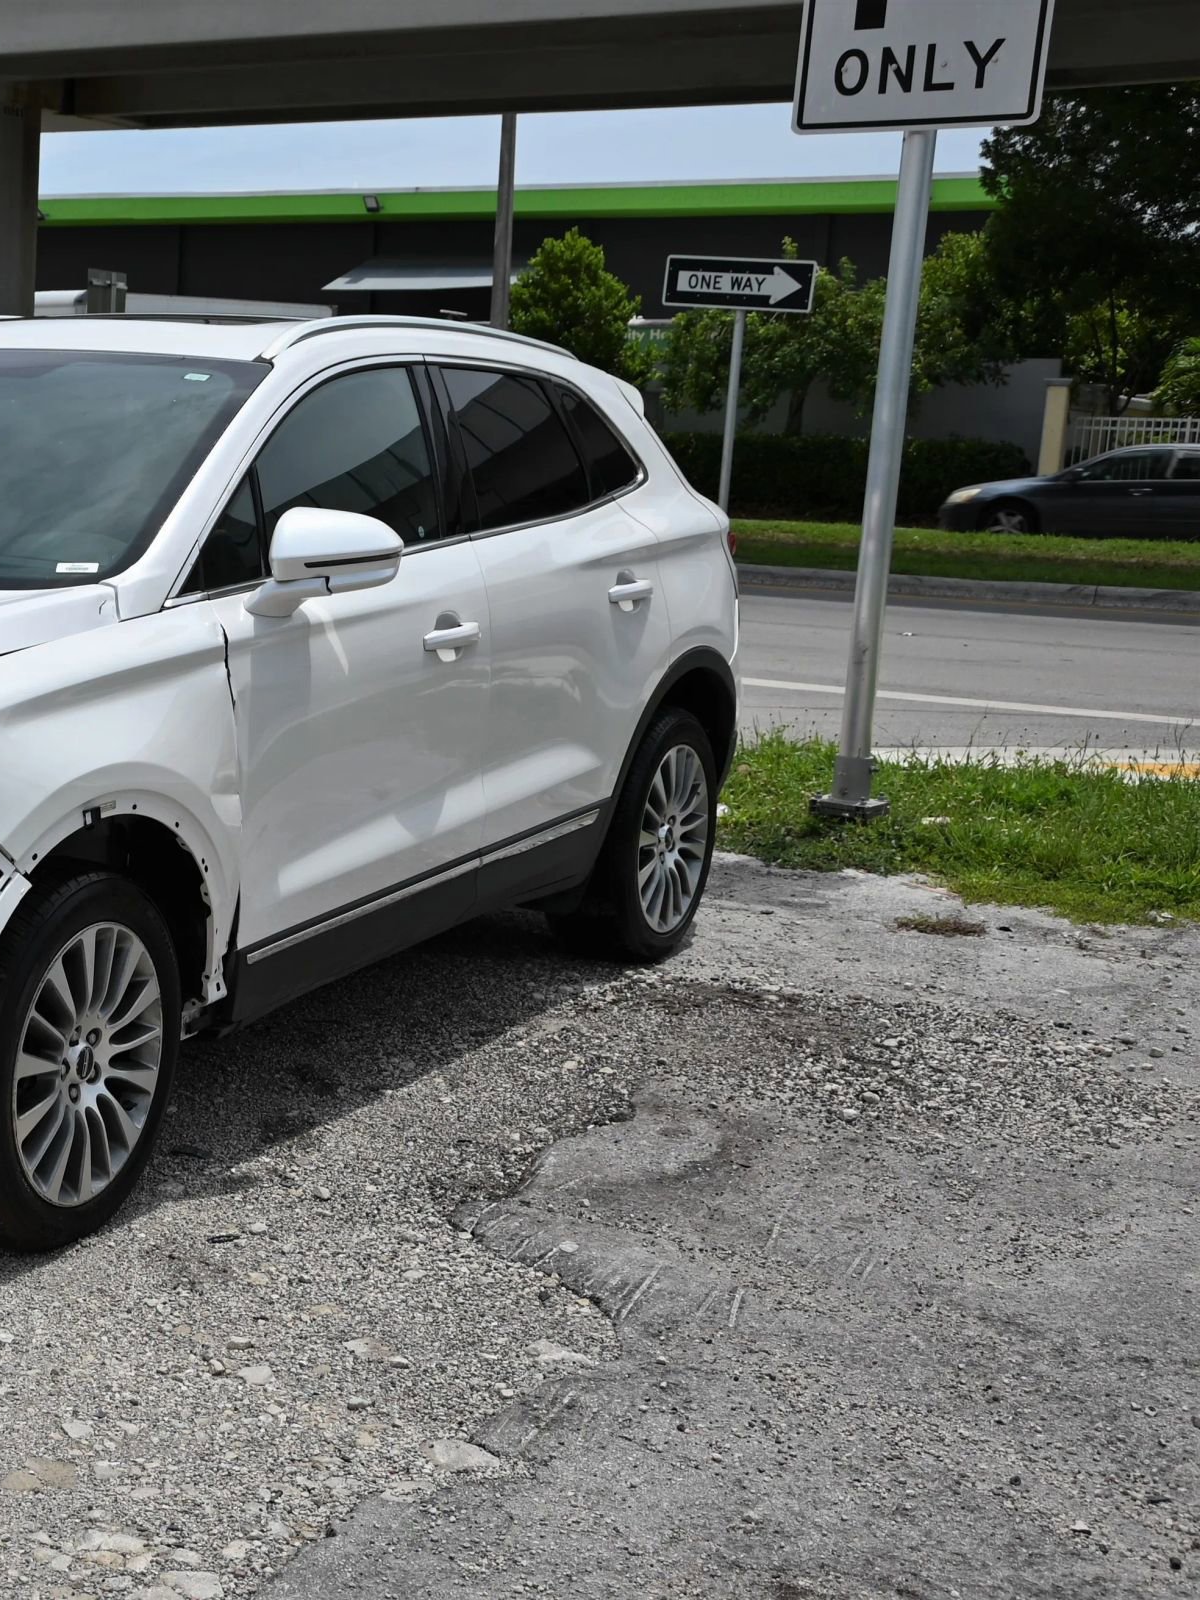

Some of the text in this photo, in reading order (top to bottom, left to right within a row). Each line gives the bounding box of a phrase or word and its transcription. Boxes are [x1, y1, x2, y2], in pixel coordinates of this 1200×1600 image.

[834, 38, 1006, 97] ONLY
[688, 273, 767, 293] ONE WAY
